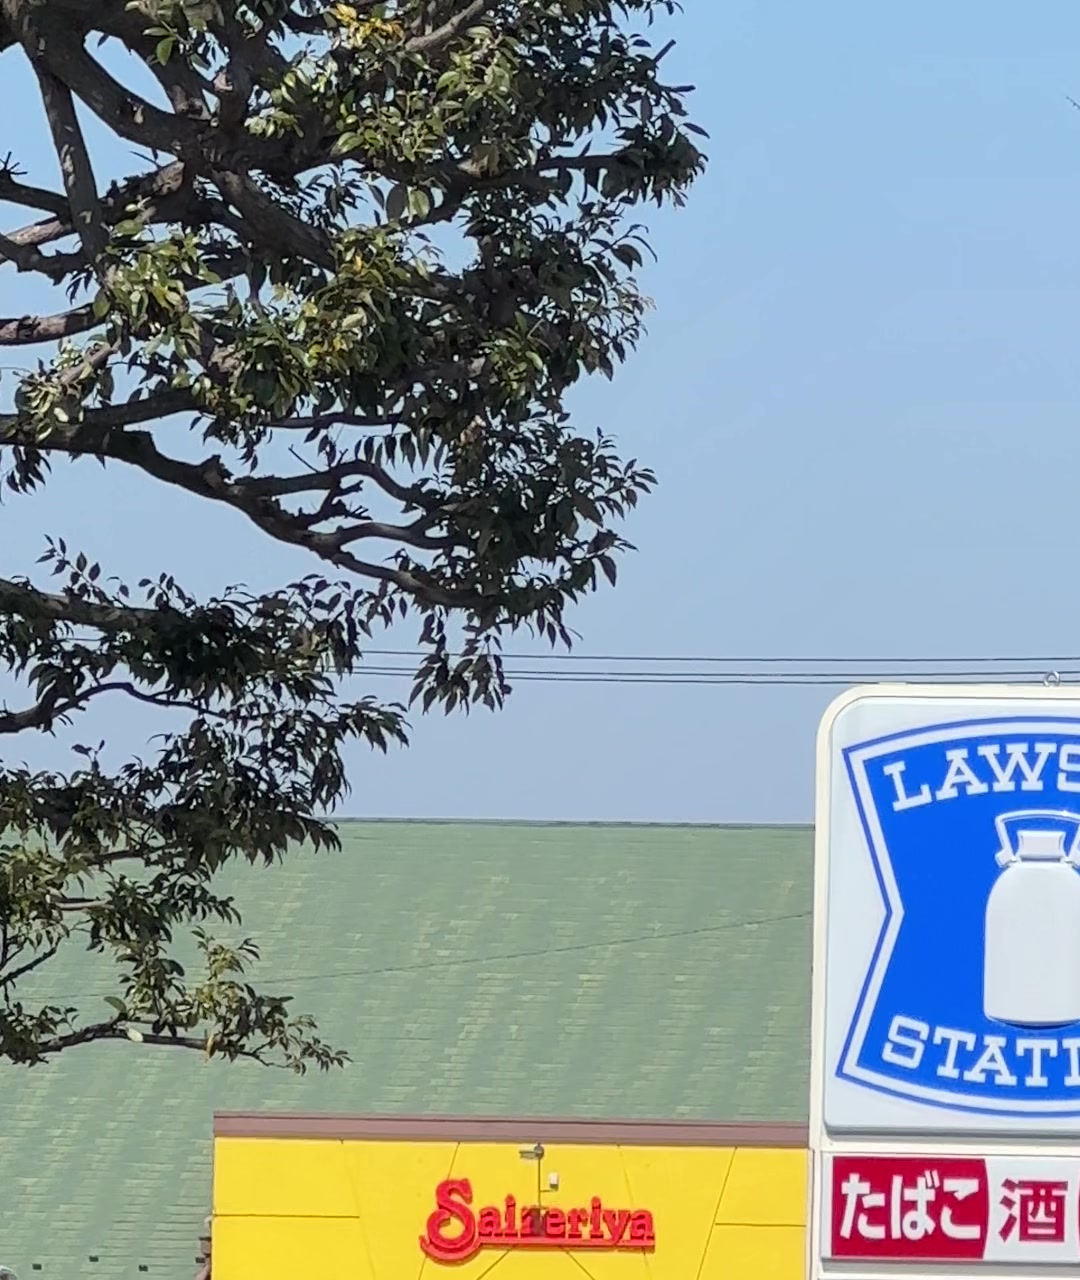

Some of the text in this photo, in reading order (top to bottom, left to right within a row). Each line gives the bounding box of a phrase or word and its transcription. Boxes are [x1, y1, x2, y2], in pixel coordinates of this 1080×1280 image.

[840, 1170, 982, 1242] たばこ
[999, 1177, 1067, 1244] 酒
